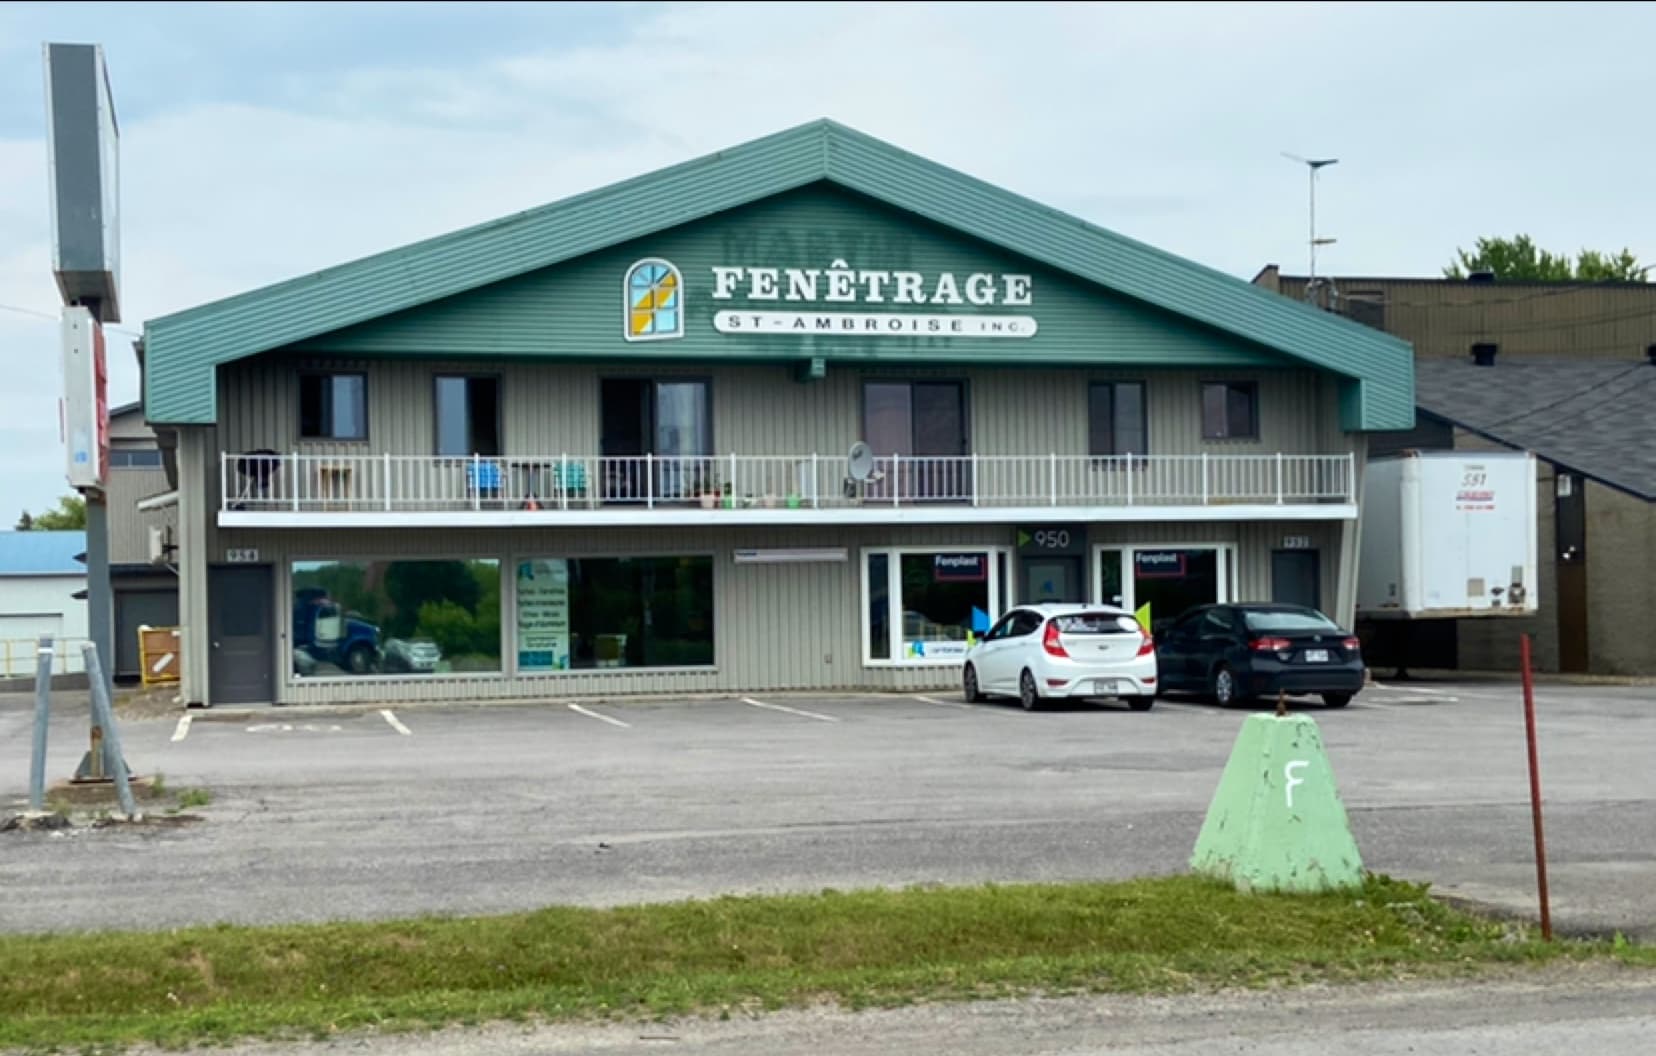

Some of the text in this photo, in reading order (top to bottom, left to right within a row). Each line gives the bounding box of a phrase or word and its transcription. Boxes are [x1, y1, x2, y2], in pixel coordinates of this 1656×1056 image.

[711, 258, 1033, 306] FENÊTRAGE
[728, 315, 1026, 332] ST-AMBROISE INC.
[1034, 530, 1071, 548] 950
[935, 555, 979, 567] Fenplast
[1135, 552, 1177, 564] Fenplast
